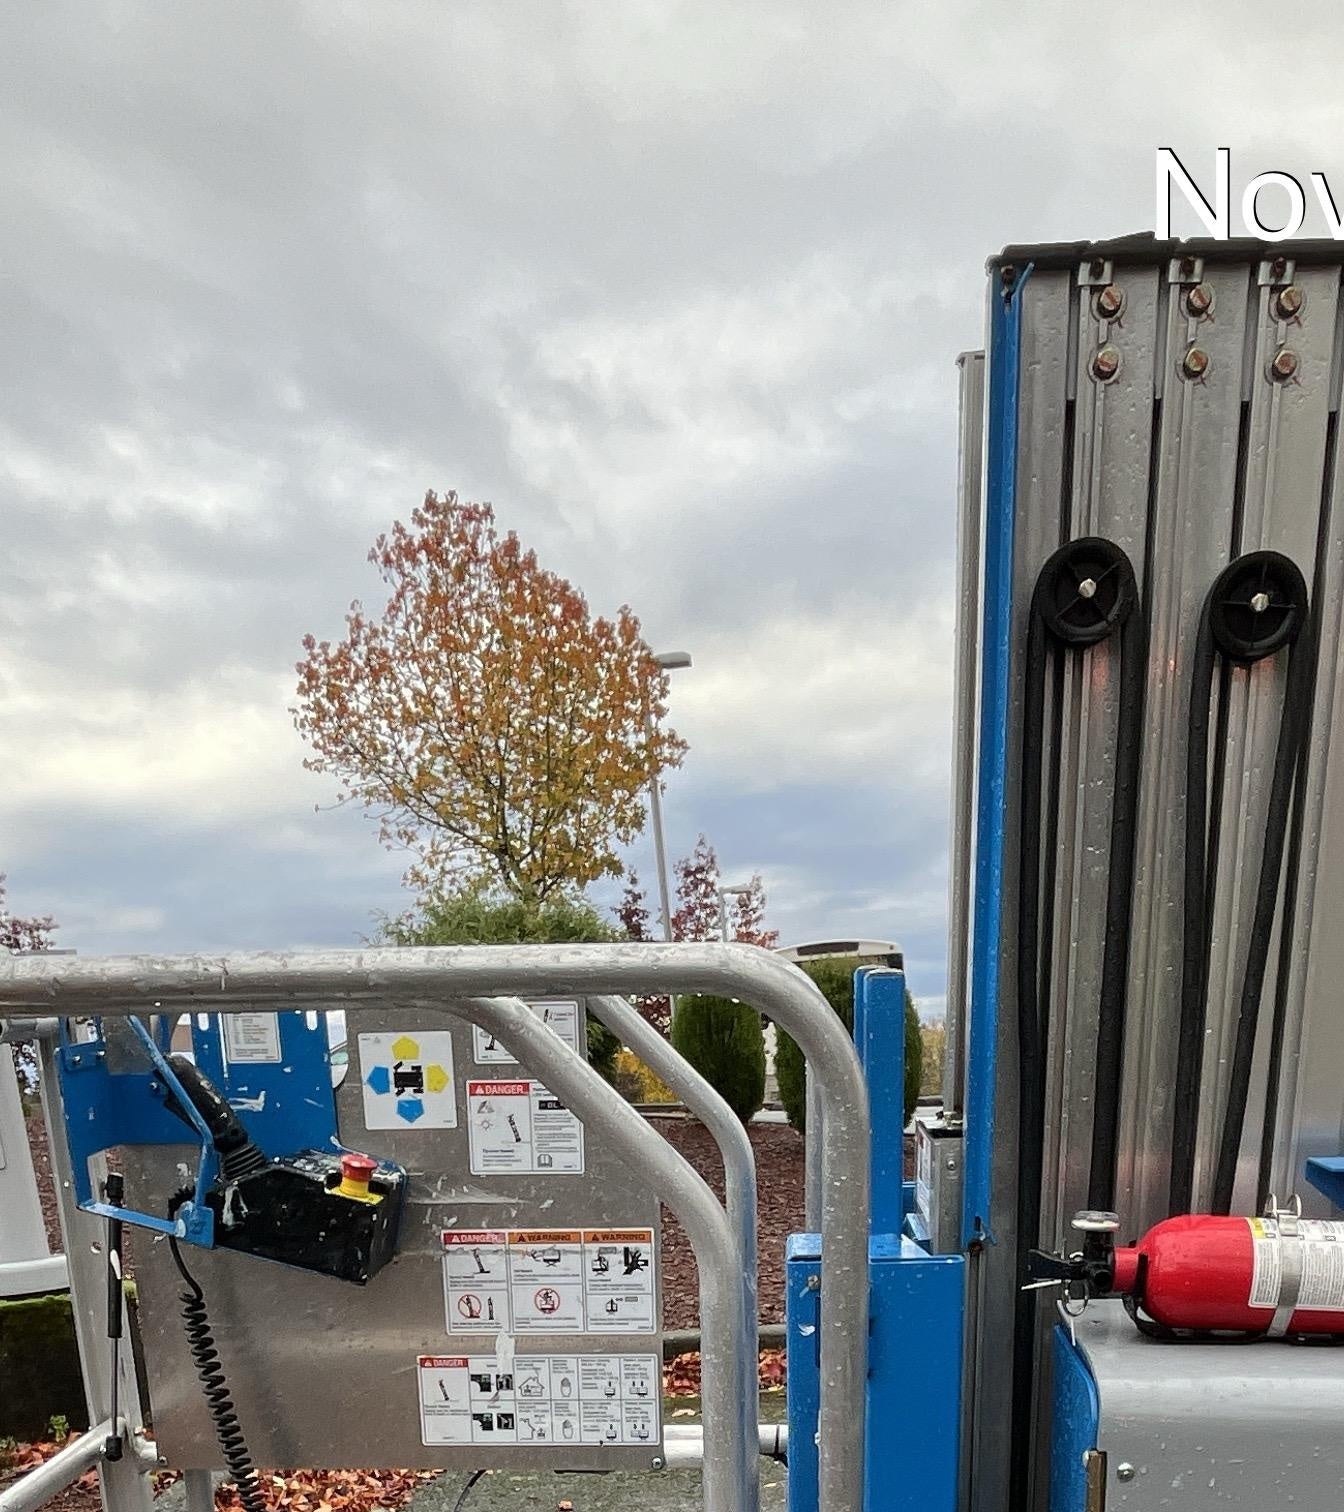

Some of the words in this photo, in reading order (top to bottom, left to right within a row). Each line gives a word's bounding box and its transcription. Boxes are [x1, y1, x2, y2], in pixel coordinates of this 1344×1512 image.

[485, 1084, 524, 1094] DANGER
[460, 1234, 498, 1243] DANGER
[527, 1233, 572, 1241] WARNING
[601, 1233, 646, 1241] WARNING
[433, 1359, 464, 1367] DANGER
